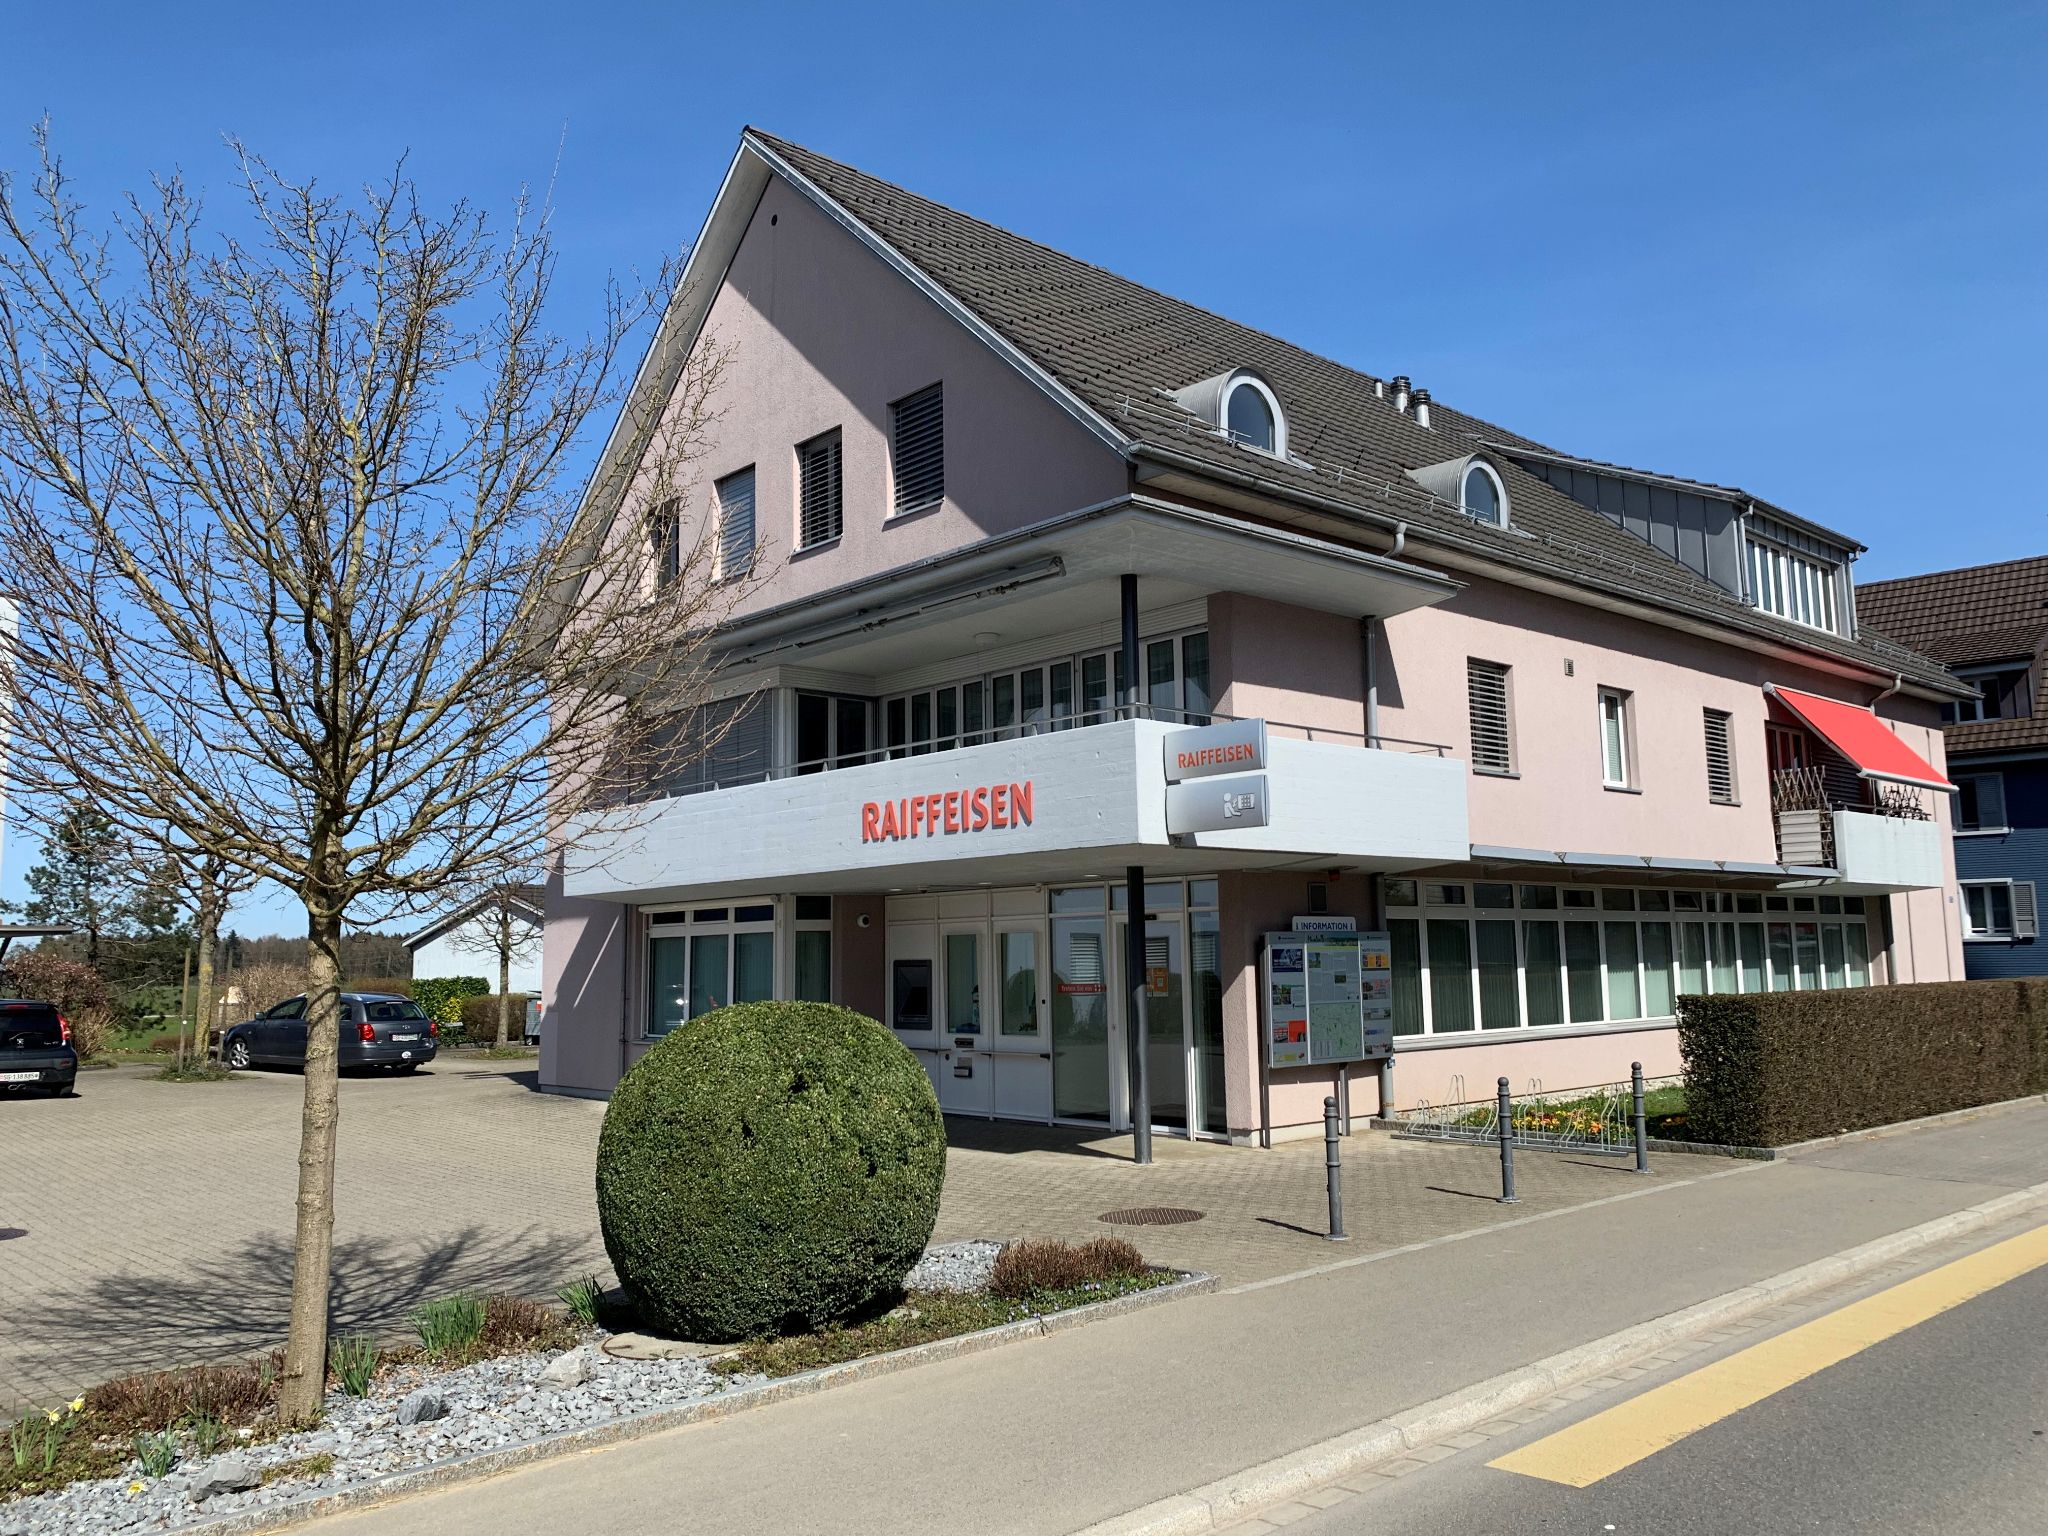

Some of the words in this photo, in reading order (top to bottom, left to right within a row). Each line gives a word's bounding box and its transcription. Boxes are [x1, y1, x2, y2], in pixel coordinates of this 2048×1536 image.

[1177, 743, 1254, 769] RAIFFEISEN
[862, 780, 1034, 844] RAIFFEISEN
[1301, 921, 1348, 930] INFORMATION
